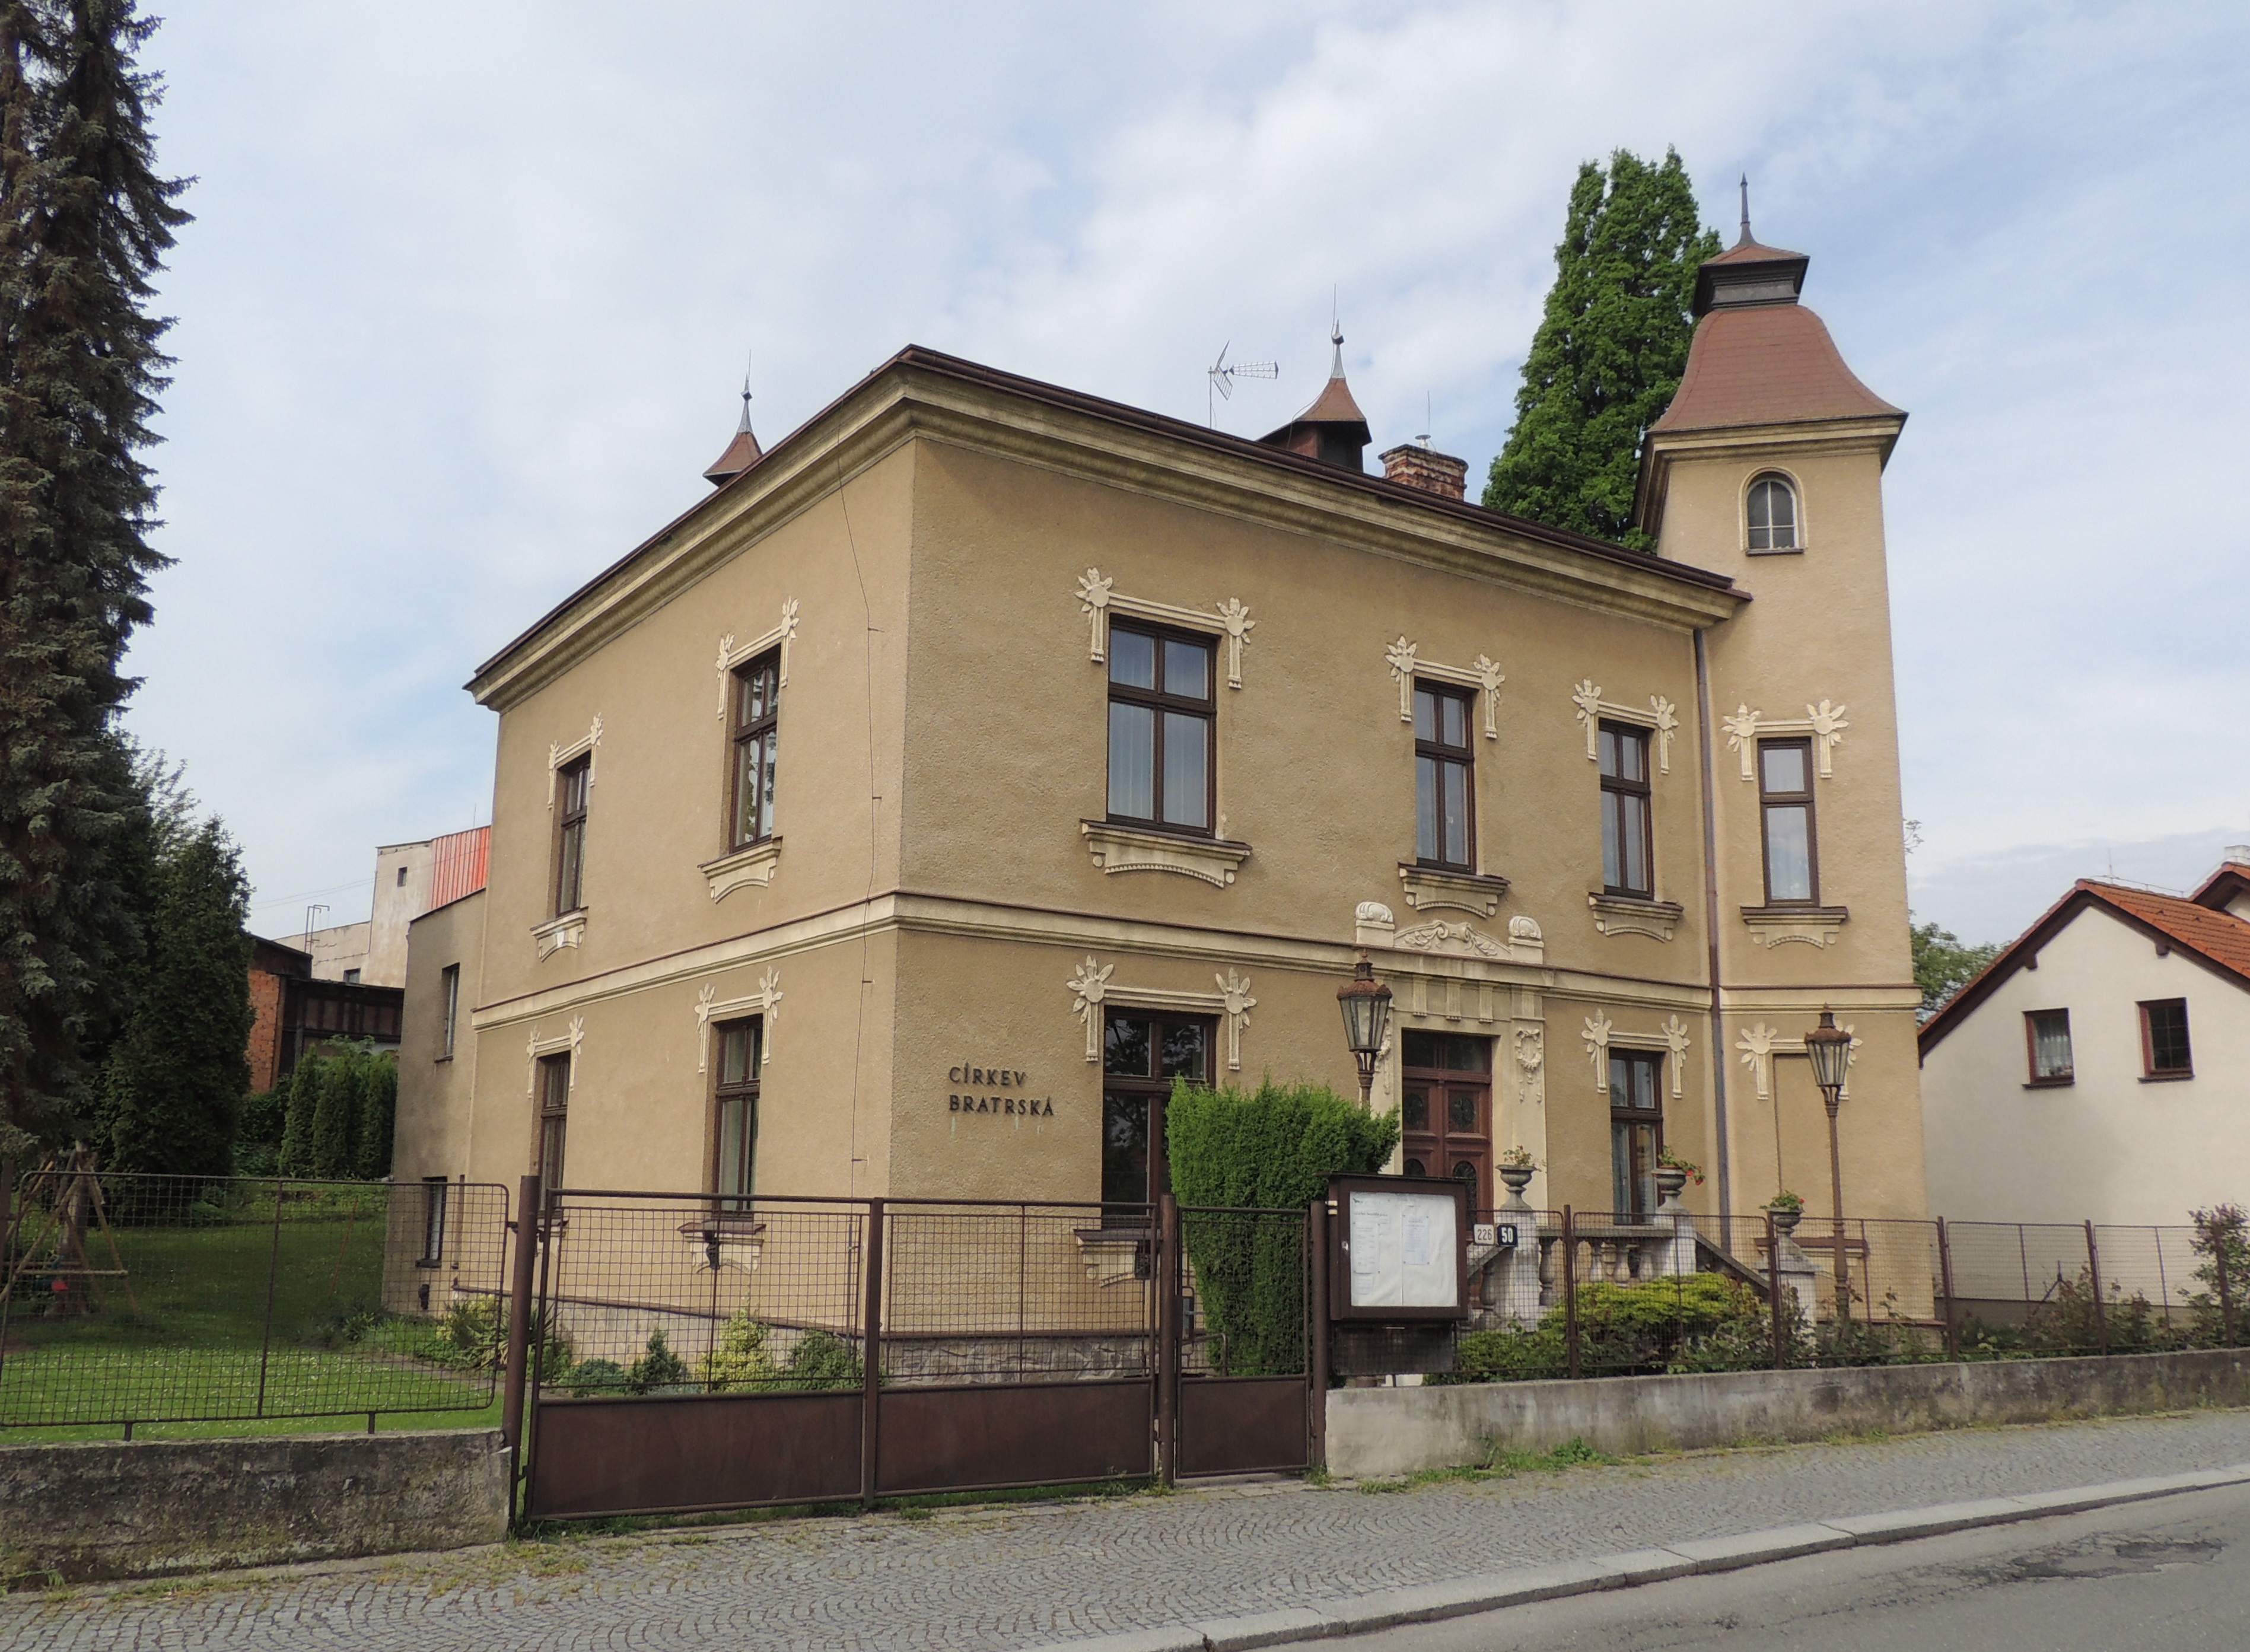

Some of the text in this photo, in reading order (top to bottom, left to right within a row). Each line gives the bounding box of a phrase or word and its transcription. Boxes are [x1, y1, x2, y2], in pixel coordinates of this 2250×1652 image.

[949, 1062, 1026, 1086] CÍRKEV
[949, 1095, 1054, 1116] BRATRSKÁ
[1477, 1228, 1492, 1240] 226
[1501, 1227, 1513, 1243] 50
